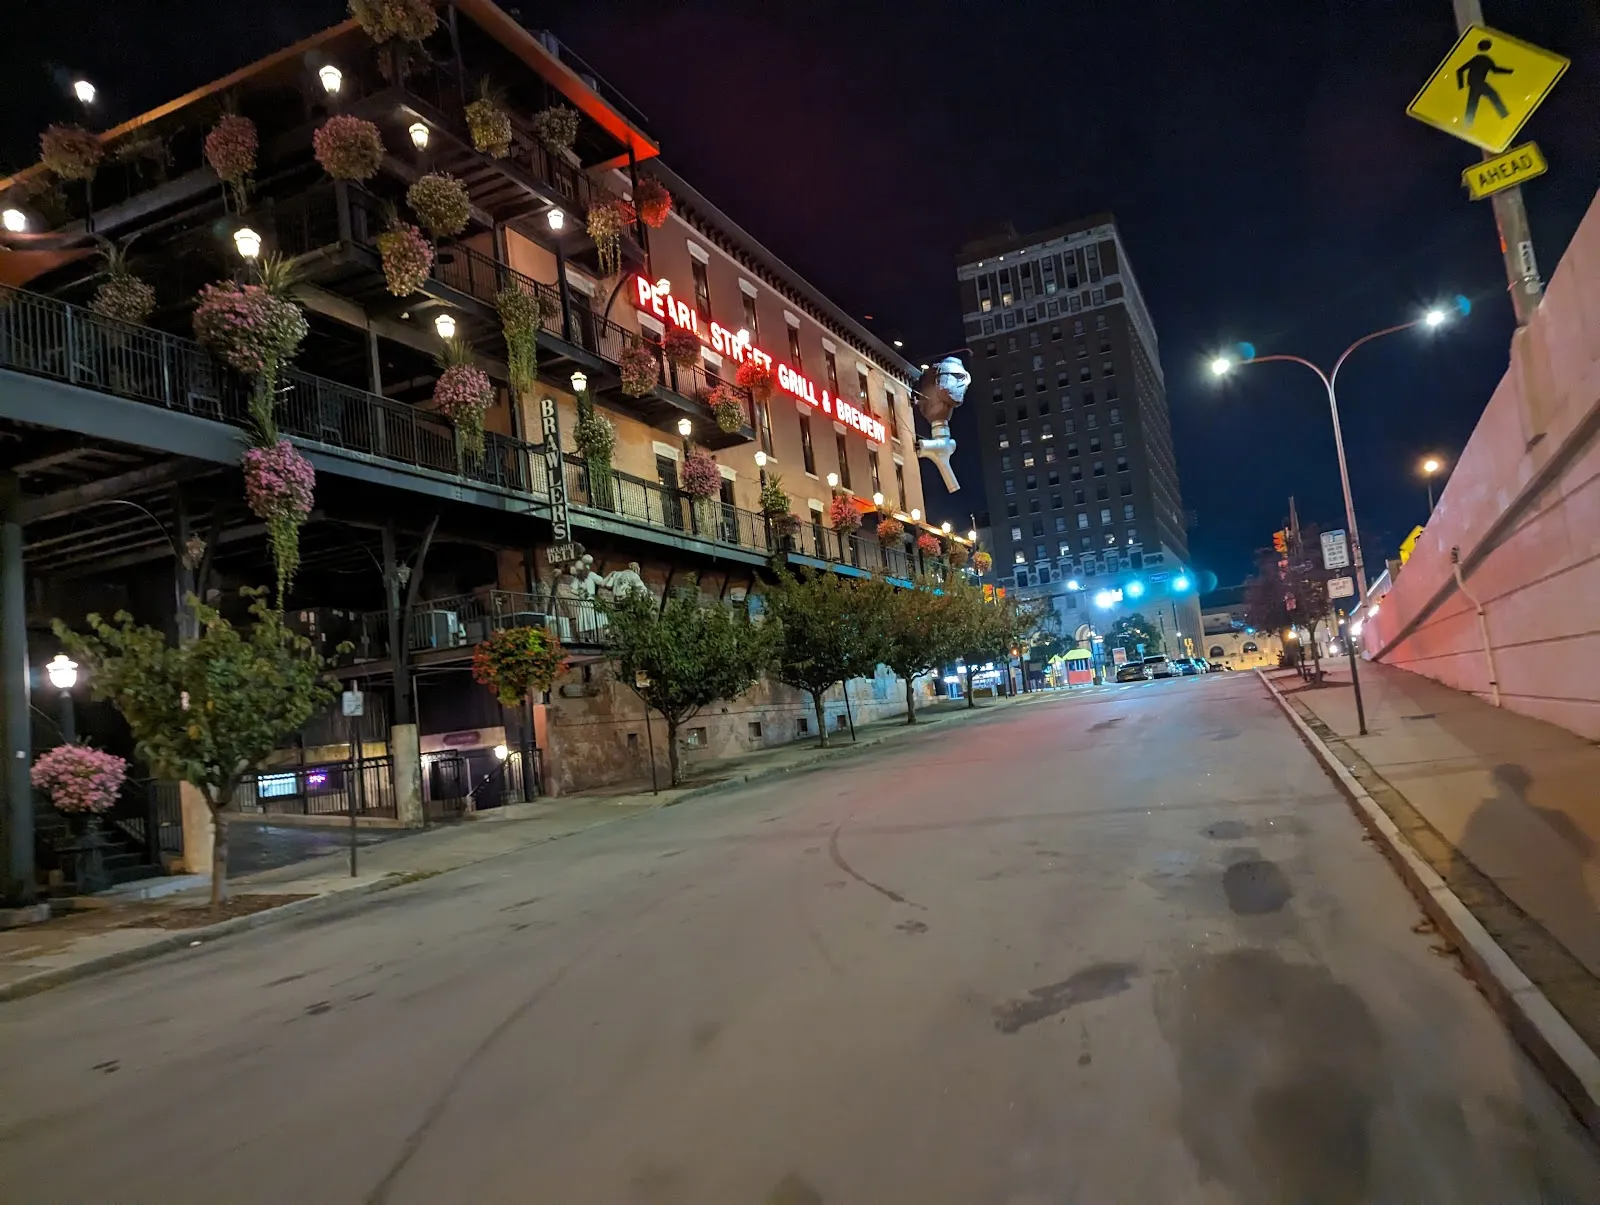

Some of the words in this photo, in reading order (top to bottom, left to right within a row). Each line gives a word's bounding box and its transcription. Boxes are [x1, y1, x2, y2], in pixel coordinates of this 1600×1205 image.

[1478, 153, 1533, 188] AHEAD
[778, 363, 819, 407] GRILL
[822, 389, 832, 414] &
[835, 397, 886, 444] BREWERY
[540, 399, 567, 540] BRAWLER'S
[547, 549, 575, 564] DELI
